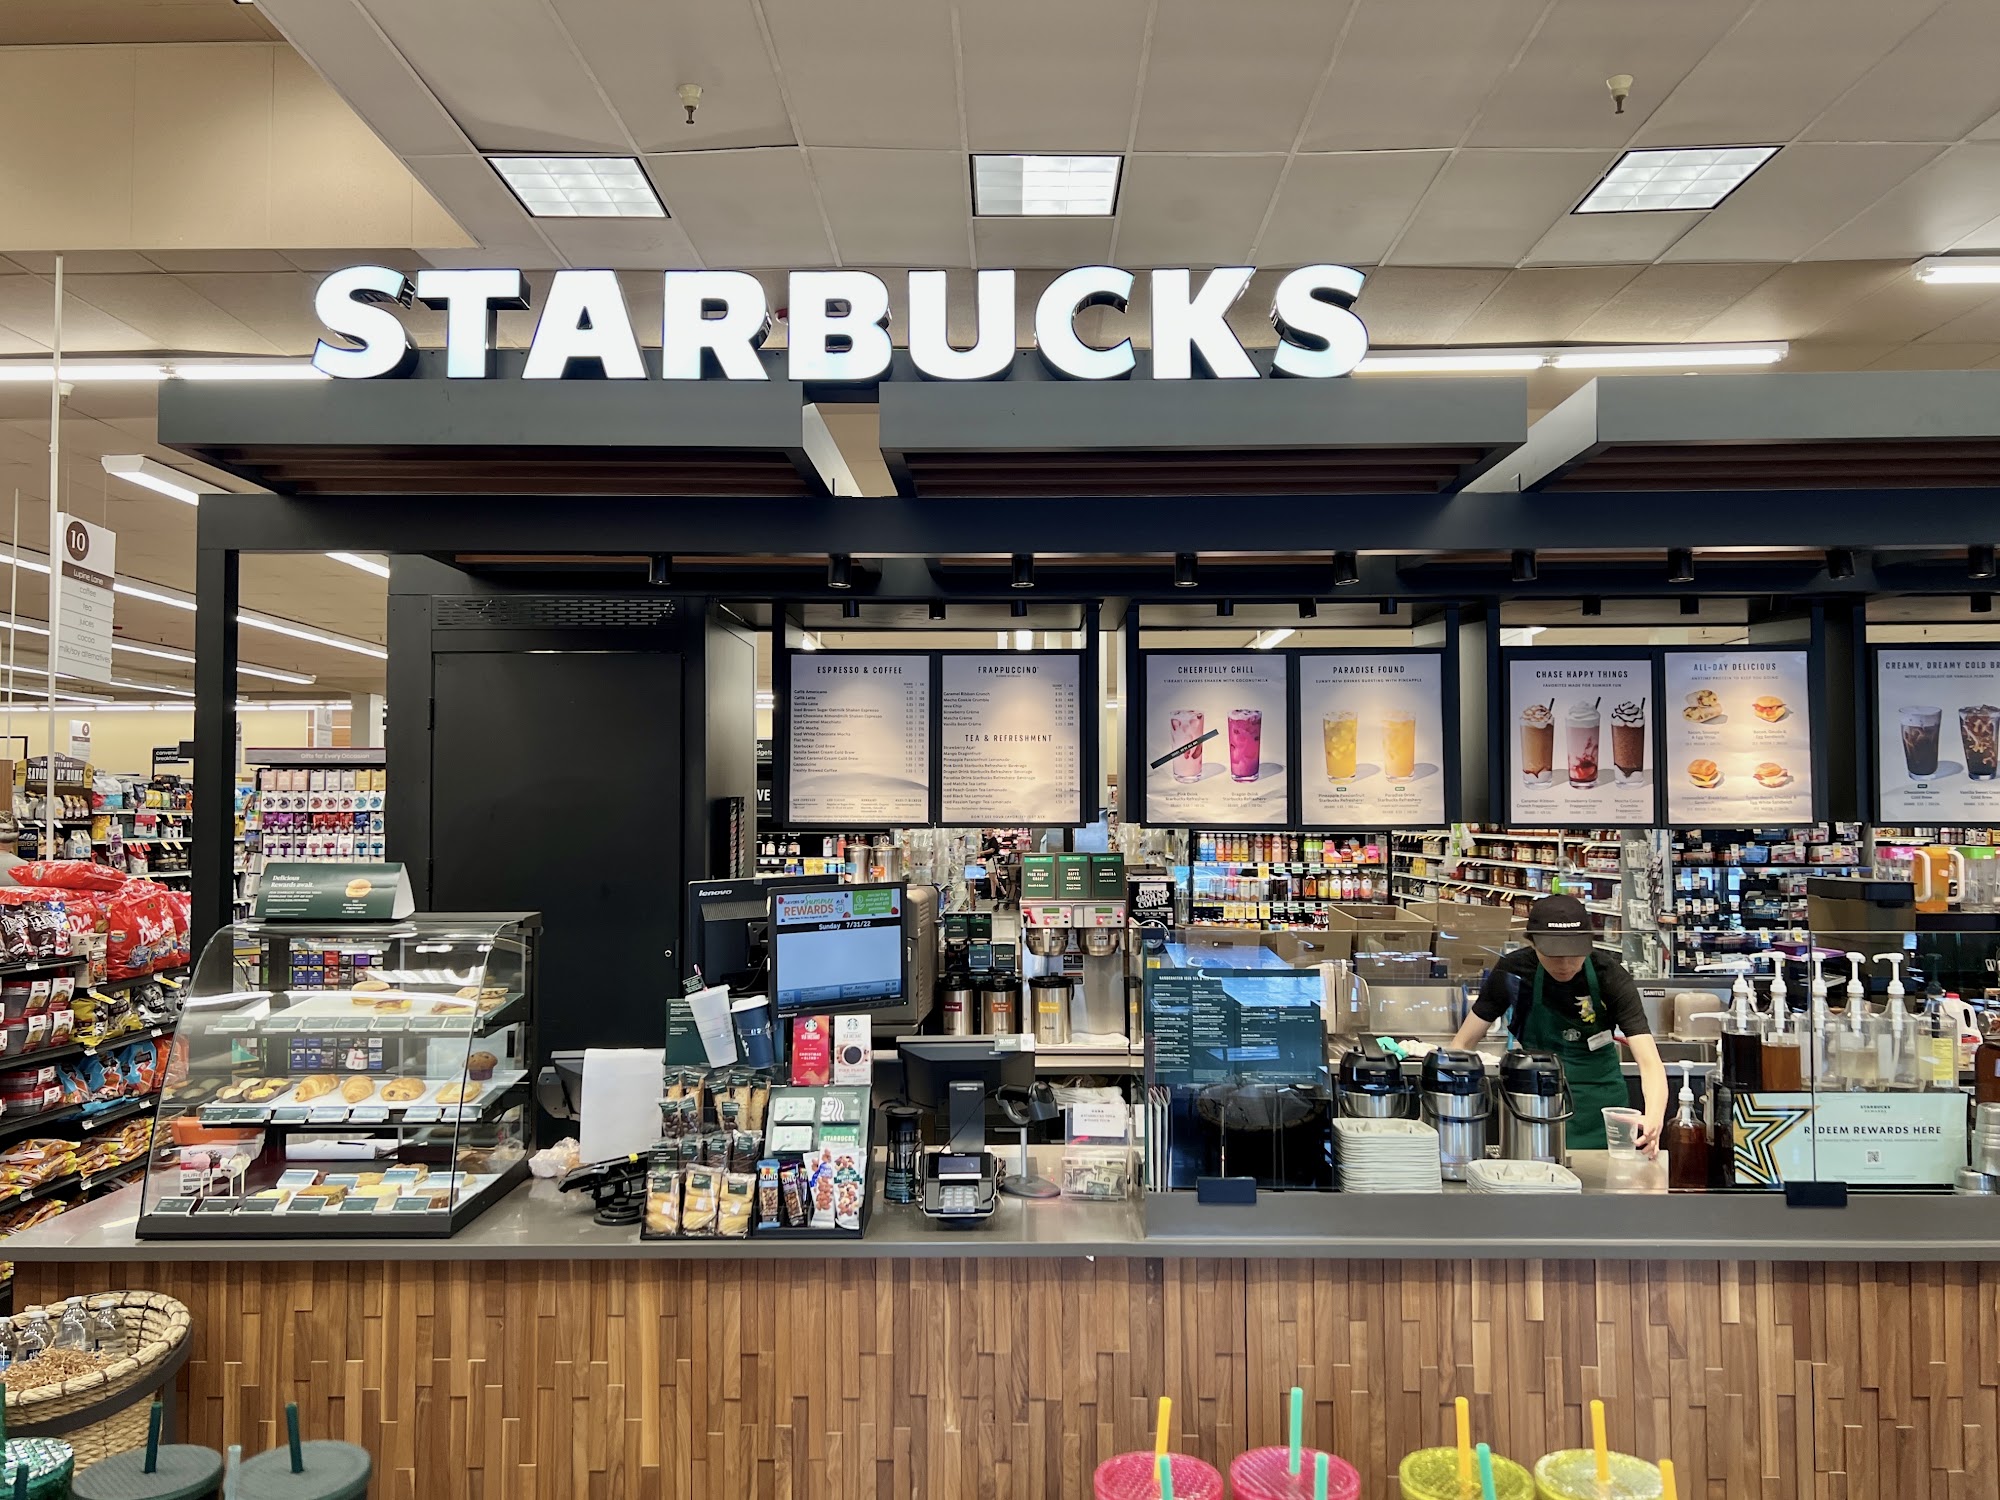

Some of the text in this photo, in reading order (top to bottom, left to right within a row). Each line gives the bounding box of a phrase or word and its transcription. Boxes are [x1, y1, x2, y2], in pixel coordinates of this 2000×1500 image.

[311, 265, 1368, 380] STARBUCKS
[70, 529, 86, 552] 10
[73, 569, 104, 586] Lupine Lane
[79, 586, 97, 598] coffee
[83, 603, 92, 612] tea
[79, 617, 94, 628] juices
[77, 633, 95, 644] cocoa
[817, 666, 902, 674] ESPRESSO & COFFEE
[1178, 666, 1227, 674] CHEERFULLY
[1333, 666, 1374, 674] PARADISE
[1694, 663, 1776, 671] ALL-DAY DELICIOUS
[1885, 662, 1922, 670] CREAMY,
[1536, 670, 1628, 679] CHASE HAPPY THINGS
[56, 768, 65, 780] AT
[66, 769, 83, 781] HOME
[698, 889, 733, 897] lenovo
[1136, 890, 1170, 902] GROUND
[805, 895, 834, 906] Summer
[1138, 898, 1169, 909] COFFEE
[784, 904, 834, 916] REWARDS
[819, 920, 871, 931] Sunday 7/31/22
[1804, 1126, 1942, 1134] RDEEM REWARDS HERE
